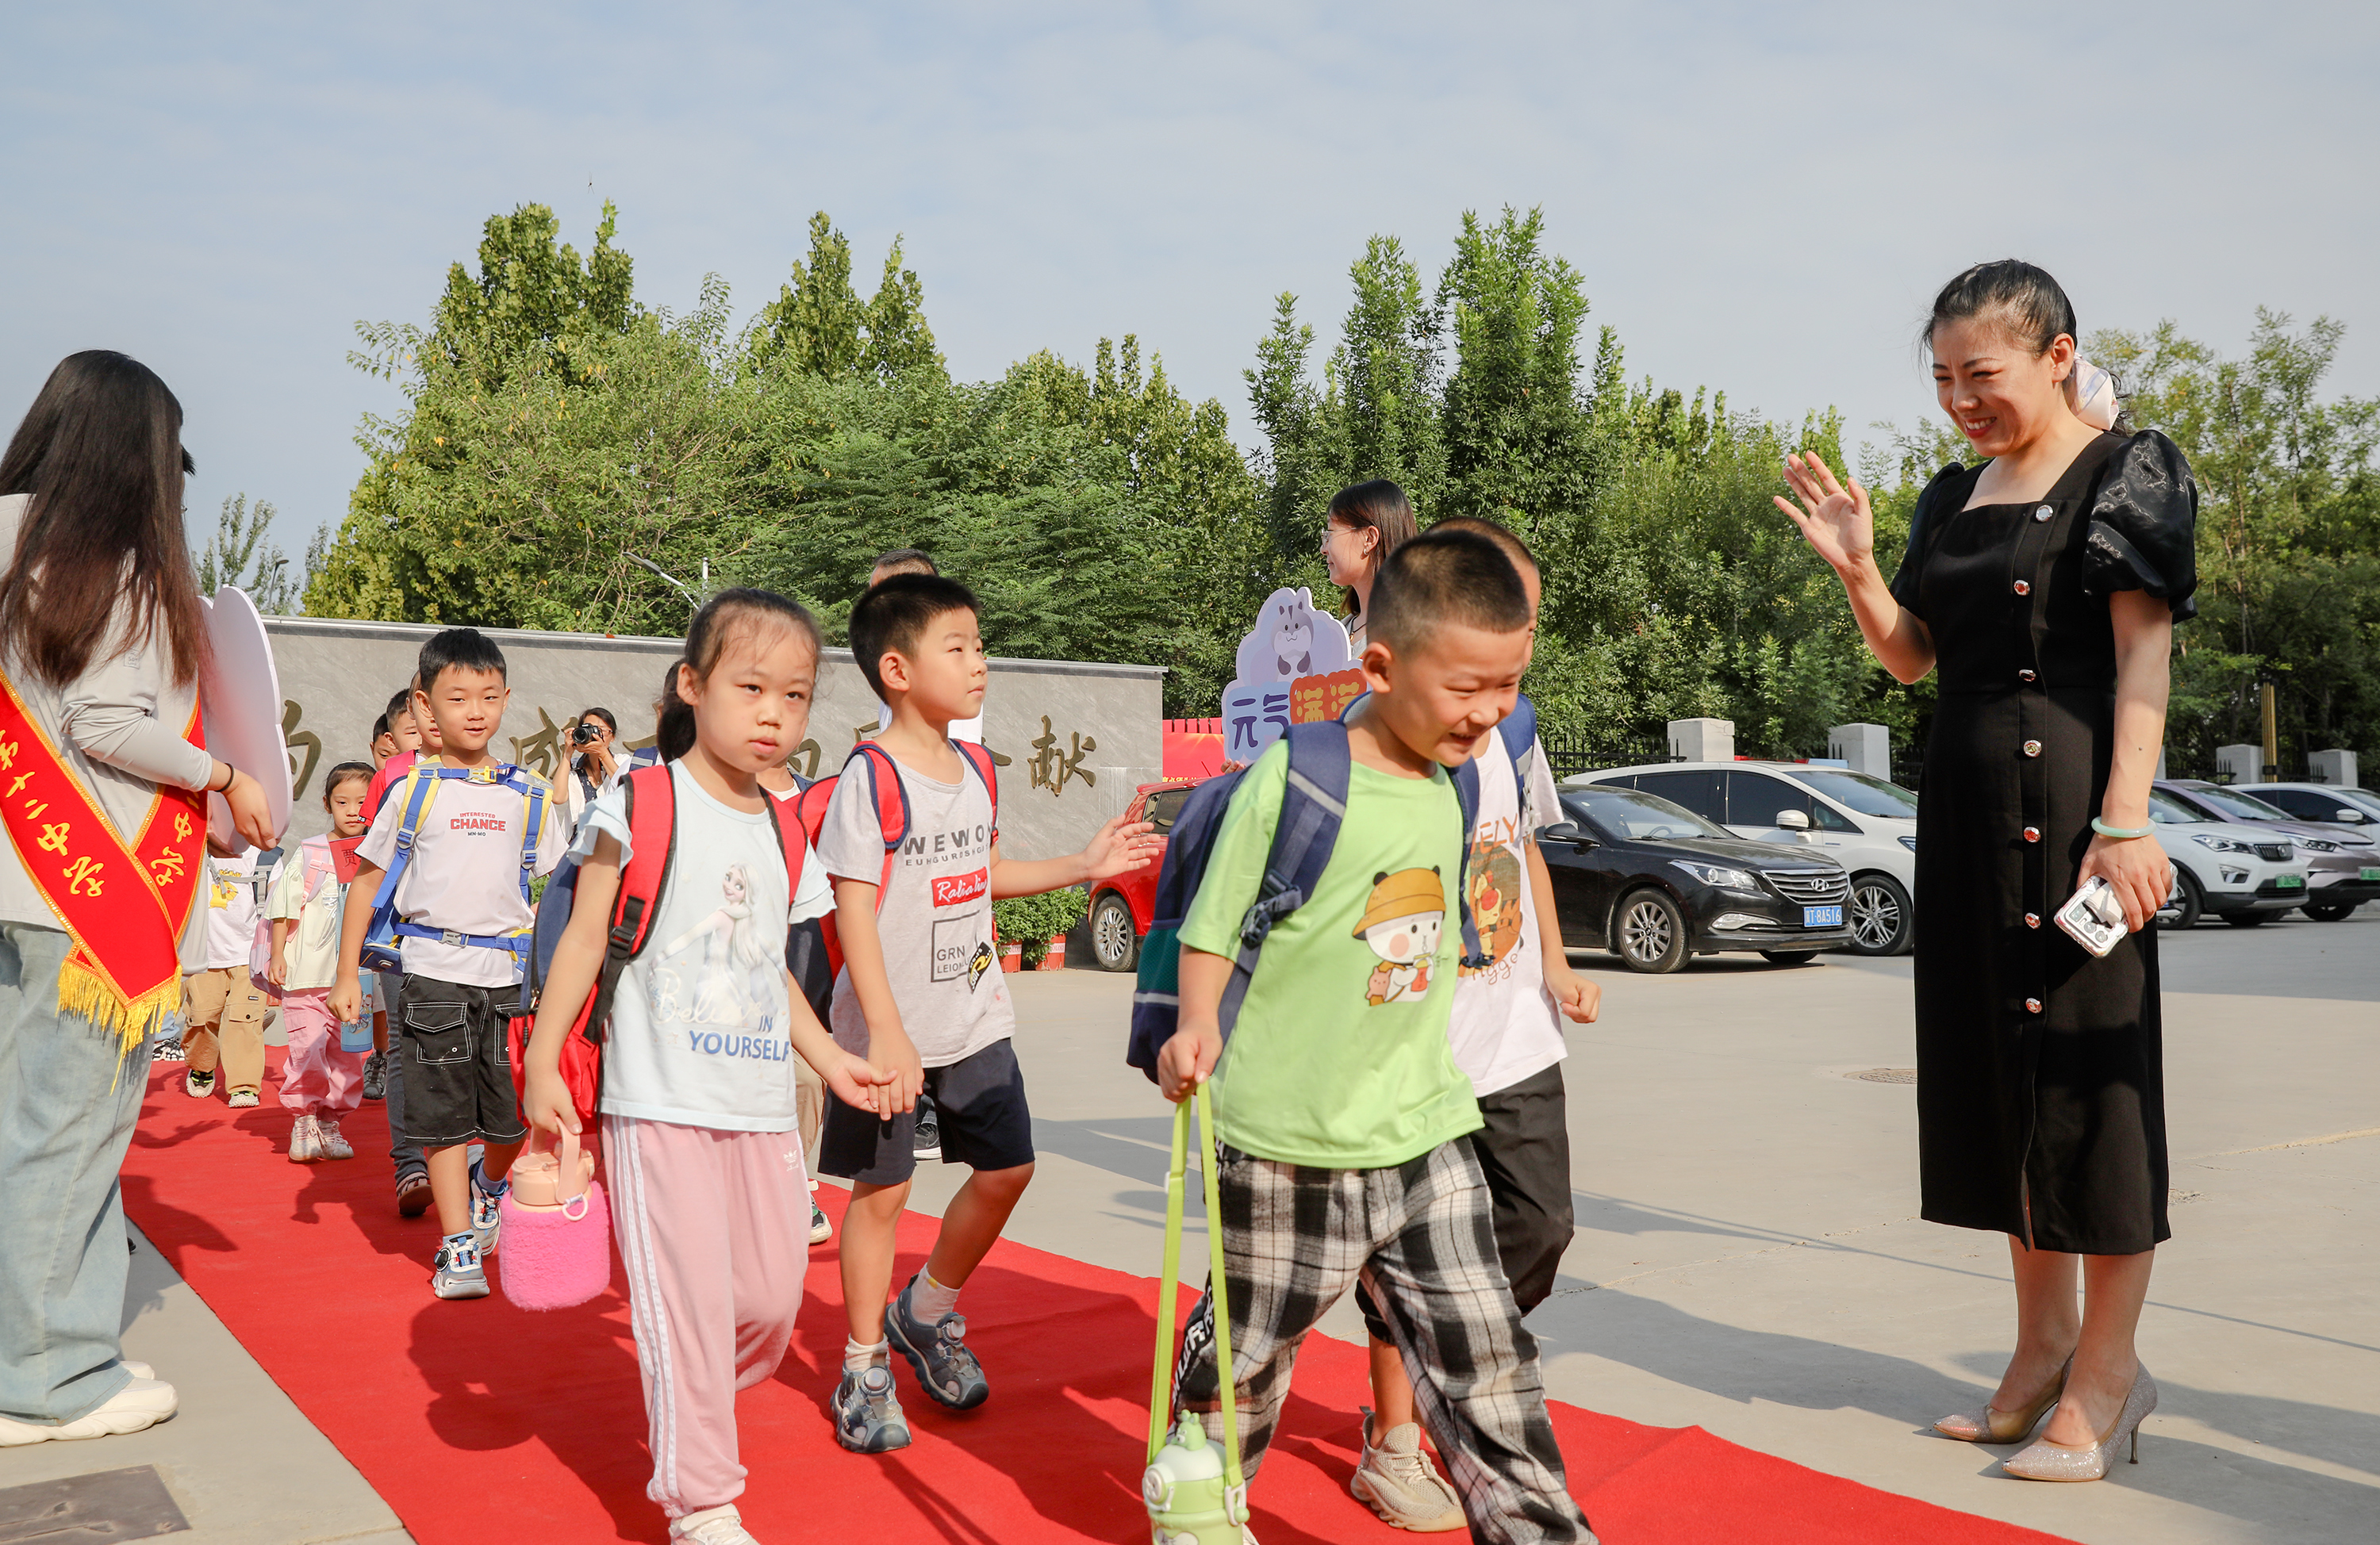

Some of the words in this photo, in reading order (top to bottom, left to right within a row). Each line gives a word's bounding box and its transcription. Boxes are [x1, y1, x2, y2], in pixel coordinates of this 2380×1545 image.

[451, 819, 506, 831] CHANCE
[904, 822, 992, 855] WEWO
[937, 945, 965, 960] GRN
[758, 1015, 774, 1033] IN
